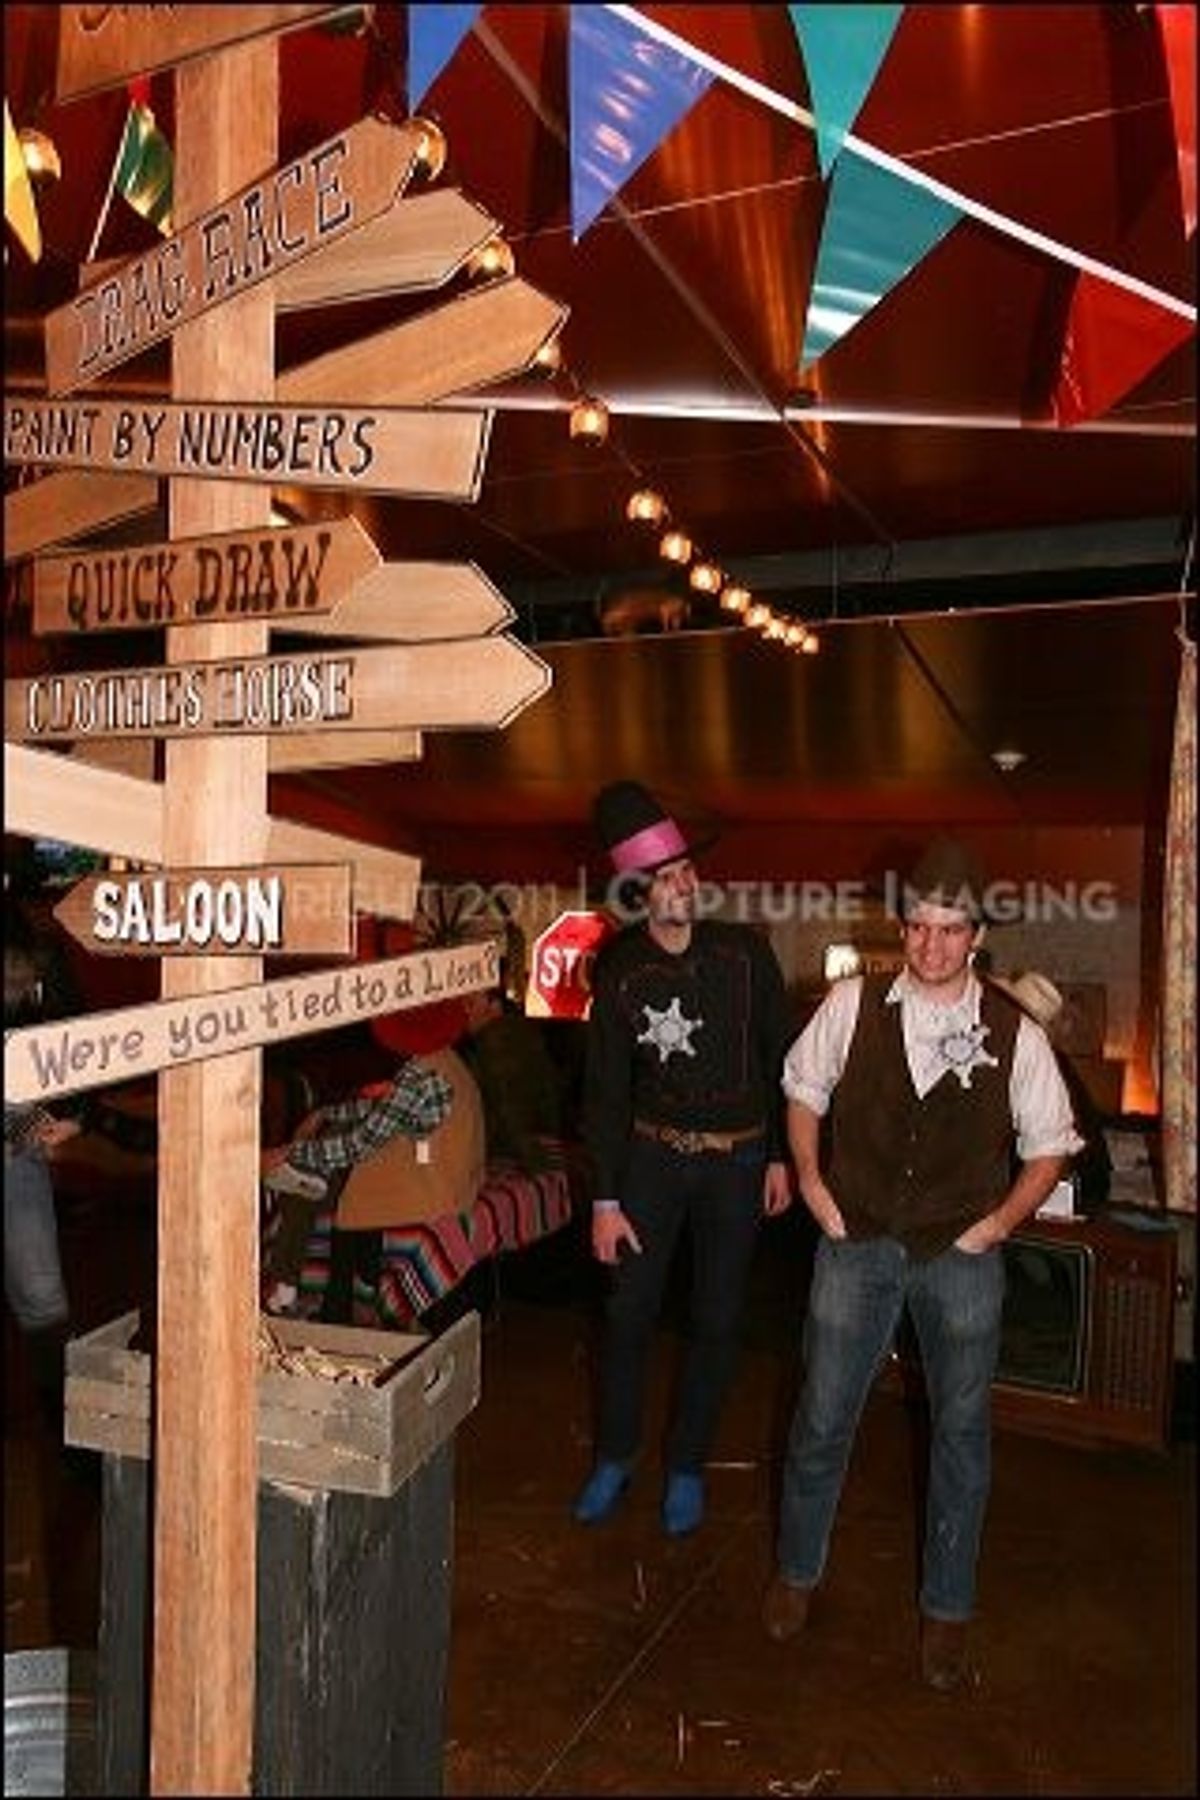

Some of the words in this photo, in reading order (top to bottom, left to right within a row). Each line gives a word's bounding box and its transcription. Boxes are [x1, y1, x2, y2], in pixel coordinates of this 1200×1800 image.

[74, 243, 184, 368] DRAG
[203, 139, 351, 299] RACE
[5, 408, 102, 457] PAINT
[112, 413, 167, 464] BY
[178, 412, 376, 475] NUMBERS
[67, 553, 180, 629] QUICK
[193, 532, 332, 613] DRAW
[27, 667, 206, 734] CLOTHES
[212, 656, 355, 728] HORSE
[93, 878, 282, 946] SALOON
[29, 1024, 145, 1090] Were
[167, 1004, 249, 1058] you
[260, 984, 345, 1030] tied
[350, 971, 388, 1006] to
[394, 965, 414, 999] a
